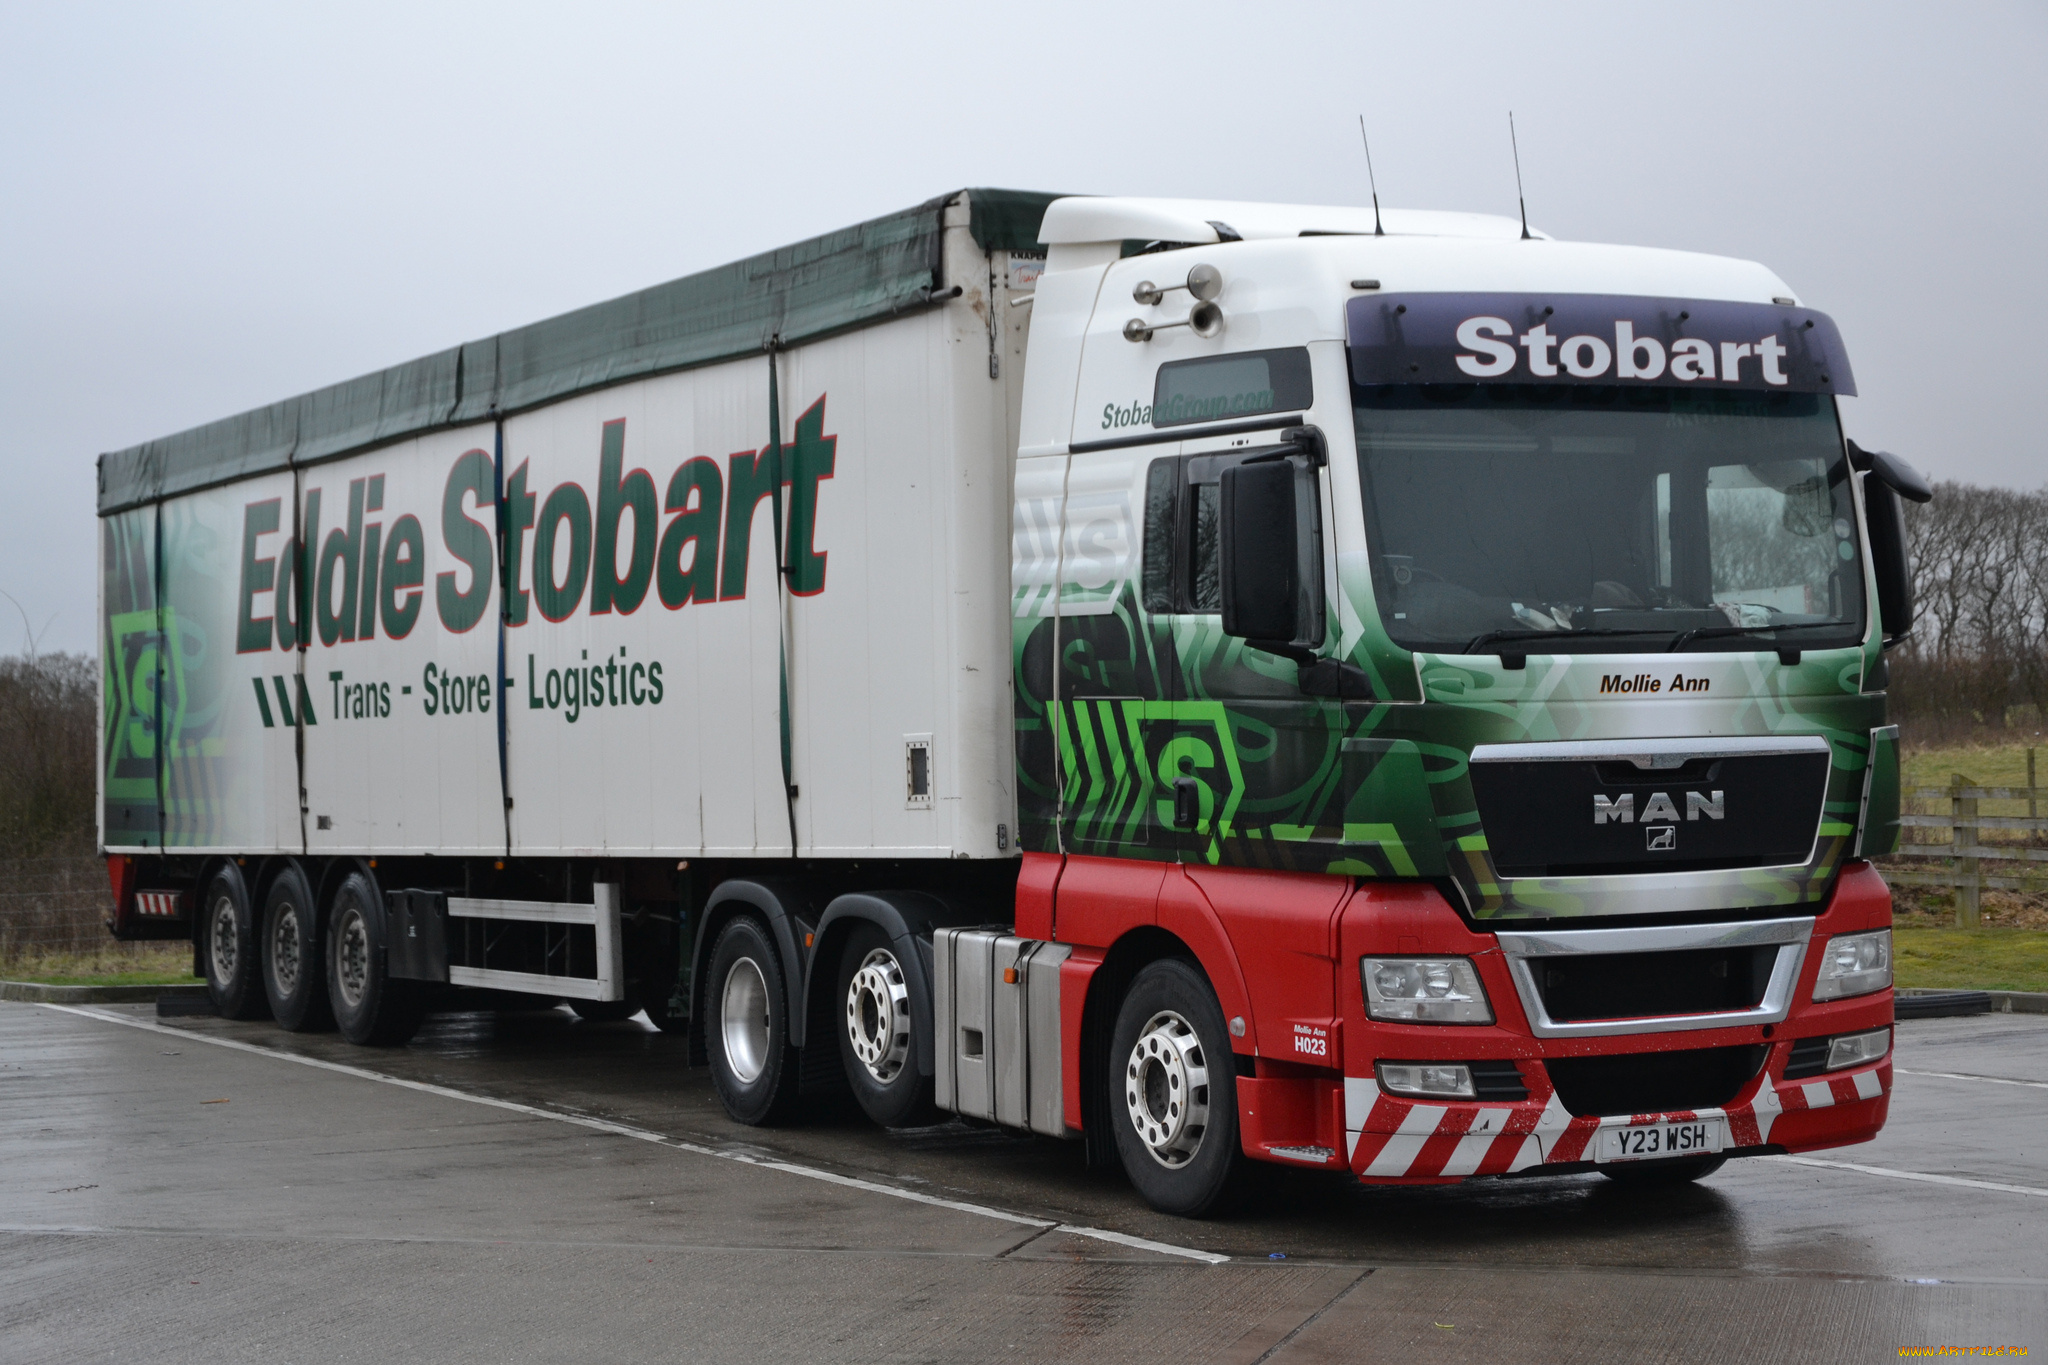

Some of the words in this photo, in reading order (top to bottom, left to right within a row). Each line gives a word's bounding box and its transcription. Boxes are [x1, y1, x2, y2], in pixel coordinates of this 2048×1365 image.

[1454, 315, 1788, 386] Stobart
[1101, 388, 1275, 430] StobartGroup.com
[236, 472, 425, 654] Eddie
[436, 391, 838, 634] Stobart
[328, 670, 391, 720] Trans
[423, 661, 491, 716] Store
[528, 646, 664, 723] Logistics
[1600, 674, 1661, 693] Mollie
[1668, 673, 1711, 692] Ann
[1594, 790, 1725, 824] MAN
[1294, 1024, 1312, 1034] Mollie
[1313, 1027, 1326, 1036] Ann
[1295, 1035, 1326, 1056] H023
[1618, 1129, 1660, 1154] Y23
[1666, 1124, 1706, 1151] WSH
